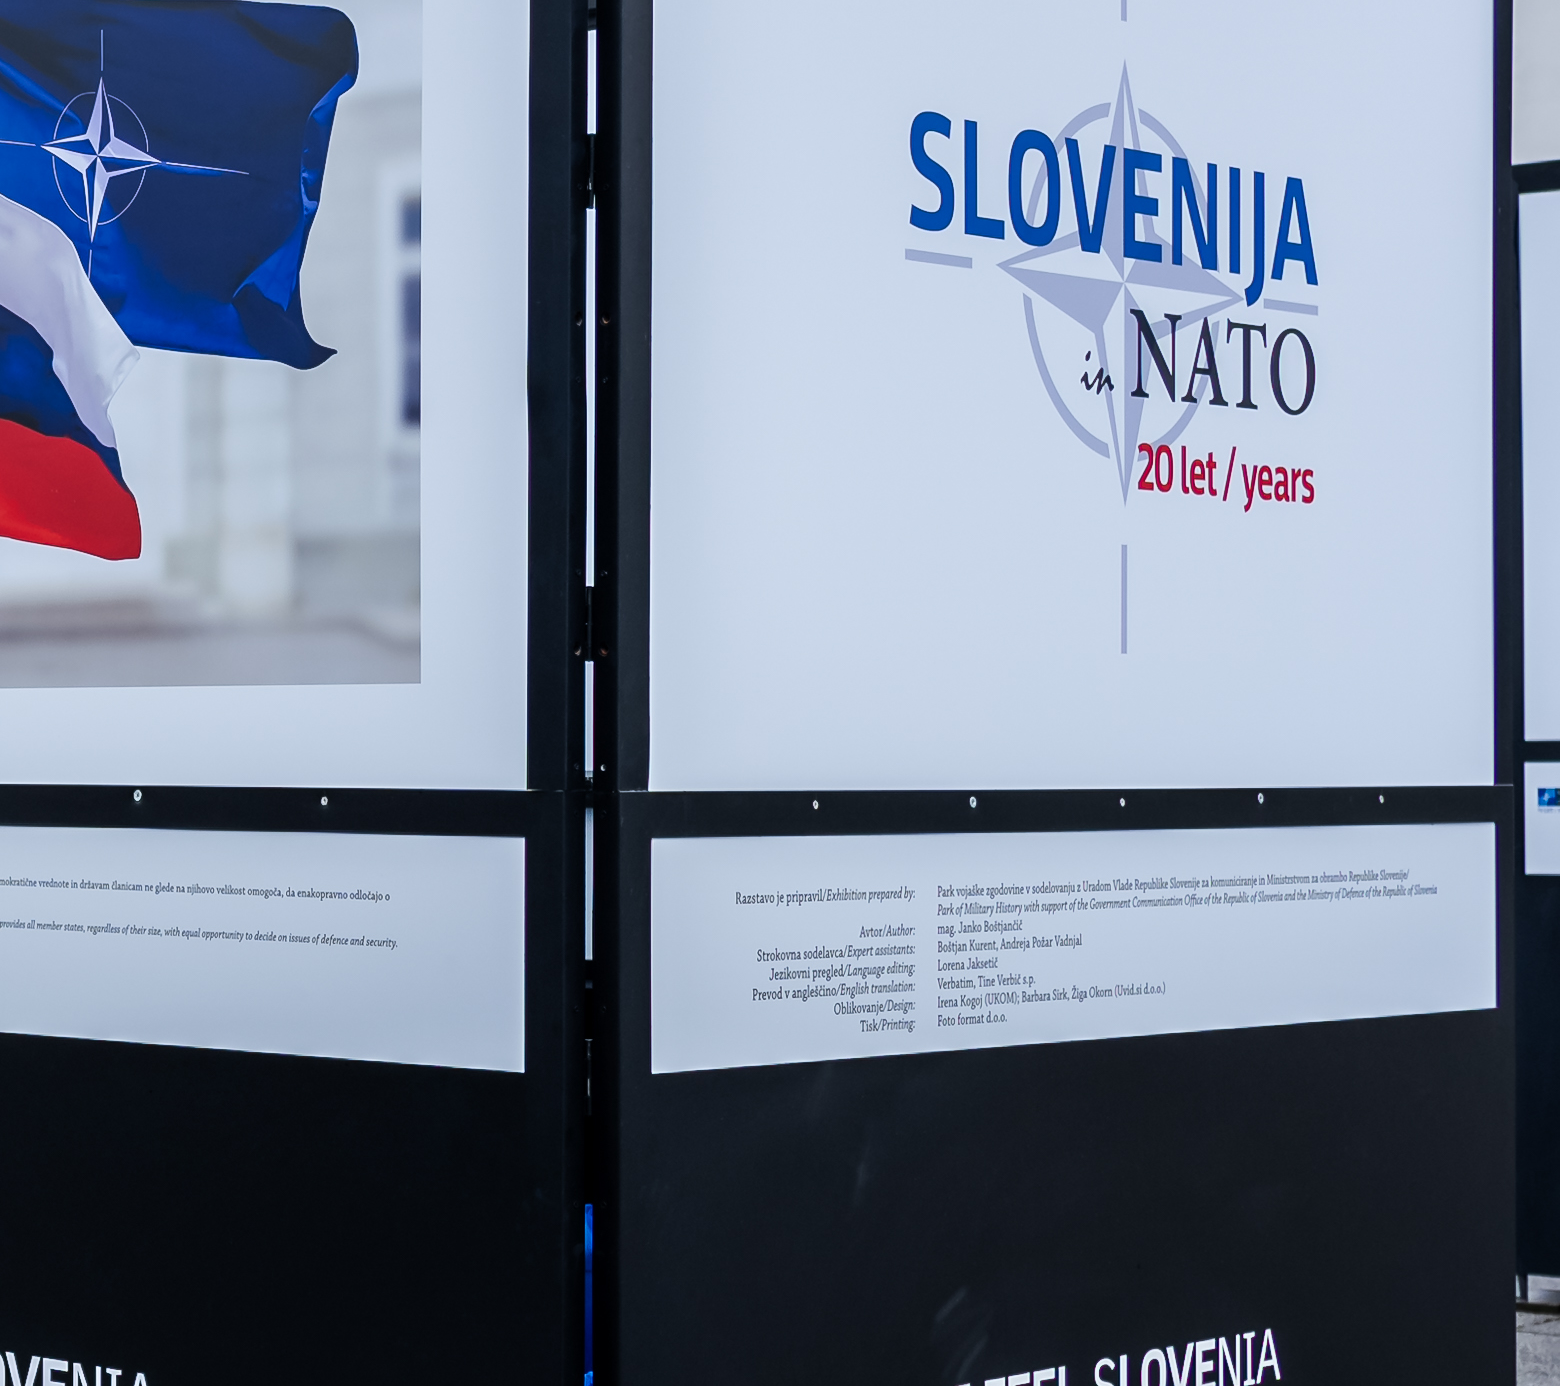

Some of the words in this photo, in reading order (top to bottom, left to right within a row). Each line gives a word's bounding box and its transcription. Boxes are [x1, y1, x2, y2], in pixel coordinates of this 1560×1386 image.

[909, 111, 1318, 307] SLOVENIJA
[1080, 351, 1115, 395] in
[1130, 309, 1316, 415] NATO
[1137, 442, 1174, 492] 20
[1181, 445, 1217, 496] let
[1241, 463, 1314, 513] years
[735, 890, 775, 904] Razstavo
[776, 890, 784, 906] je
[867, 886, 903, 903] prepared
[903, 885, 915, 902] by:
[937, 884, 955, 897] Park
[955, 883, 984, 899] vojaške
[985, 882, 1024, 899] zgodovine
[1025, 886, 1031, 894] v
[1031, 880, 1075, 897] sodelovanju
[1076, 884, 1081, 892] z
[1082, 879, 1111, 892] Uradom
[1112, 878, 1133, 890] Vlade
[937, 902, 954, 915] Park
[955, 902, 963, 917] of
[963, 901, 994, 918] Military
[995, 900, 1022, 917] History
[1023, 899, 1039, 912] with
[1041, 901, 1067, 914] support
[1068, 898, 1077, 912] of
[1077, 897, 1088, 910] the
[1089, 896, 1130, 909] Government
[26, 919, 35, 929] all
[36, 920, 62, 930] member
[64, 923, 85, 932] states,
[86, 922, 120, 936] regardless
[121, 924, 129, 935] of
[129, 924, 146, 934] their
[147, 926, 162, 936] size,
[164, 926, 180, 936] with
[181, 927, 200, 940] equal
[201, 929, 243, 942] opportunity
[245, 932, 252, 940] to
[253, 930, 276, 941] decide
[288, 933, 310, 943] issues
[311, 933, 320, 945] of
[320, 933, 348, 946] defence
[349, 935, 364, 945] and
[365, 937, 397, 950] security.
[937, 925, 956, 938] mag.
[957, 919, 982, 933] Janko
[756, 946, 802, 962] Strokovna
[874, 942, 915, 956] assistants:
[937, 939, 968, 956] Boštjan
[969, 938, 998, 952] Kurent,
[999, 935, 1030, 952] Andreja
[1032, 935, 1053, 947] Požar
[1054, 933, 1082, 950] Vadnjal
[768, 965, 810, 980] Jezikovni
[886, 960, 915, 978] editing:
[937, 957, 965, 971] Lorena
[752, 986, 782, 1001] Prevod
[784, 990, 790, 998] v
[870, 978, 915, 993] translation:
[937, 975, 976, 991] Verbatim,
[977, 974, 995, 987] Tine
[1022, 975, 1035, 988] s.p.
[937, 994, 958, 1008] Irena
[959, 993, 983, 1010] Kogoj
[1021, 988, 1051, 1002] Barbara
[1052, 987, 1070, 1002] Sirk,
[1088, 984, 1112, 998] Okorn
[937, 1013, 956, 1026] Foto
[957, 1010, 984, 1025] format
[985, 1009, 1007, 1023] d.o.o.
